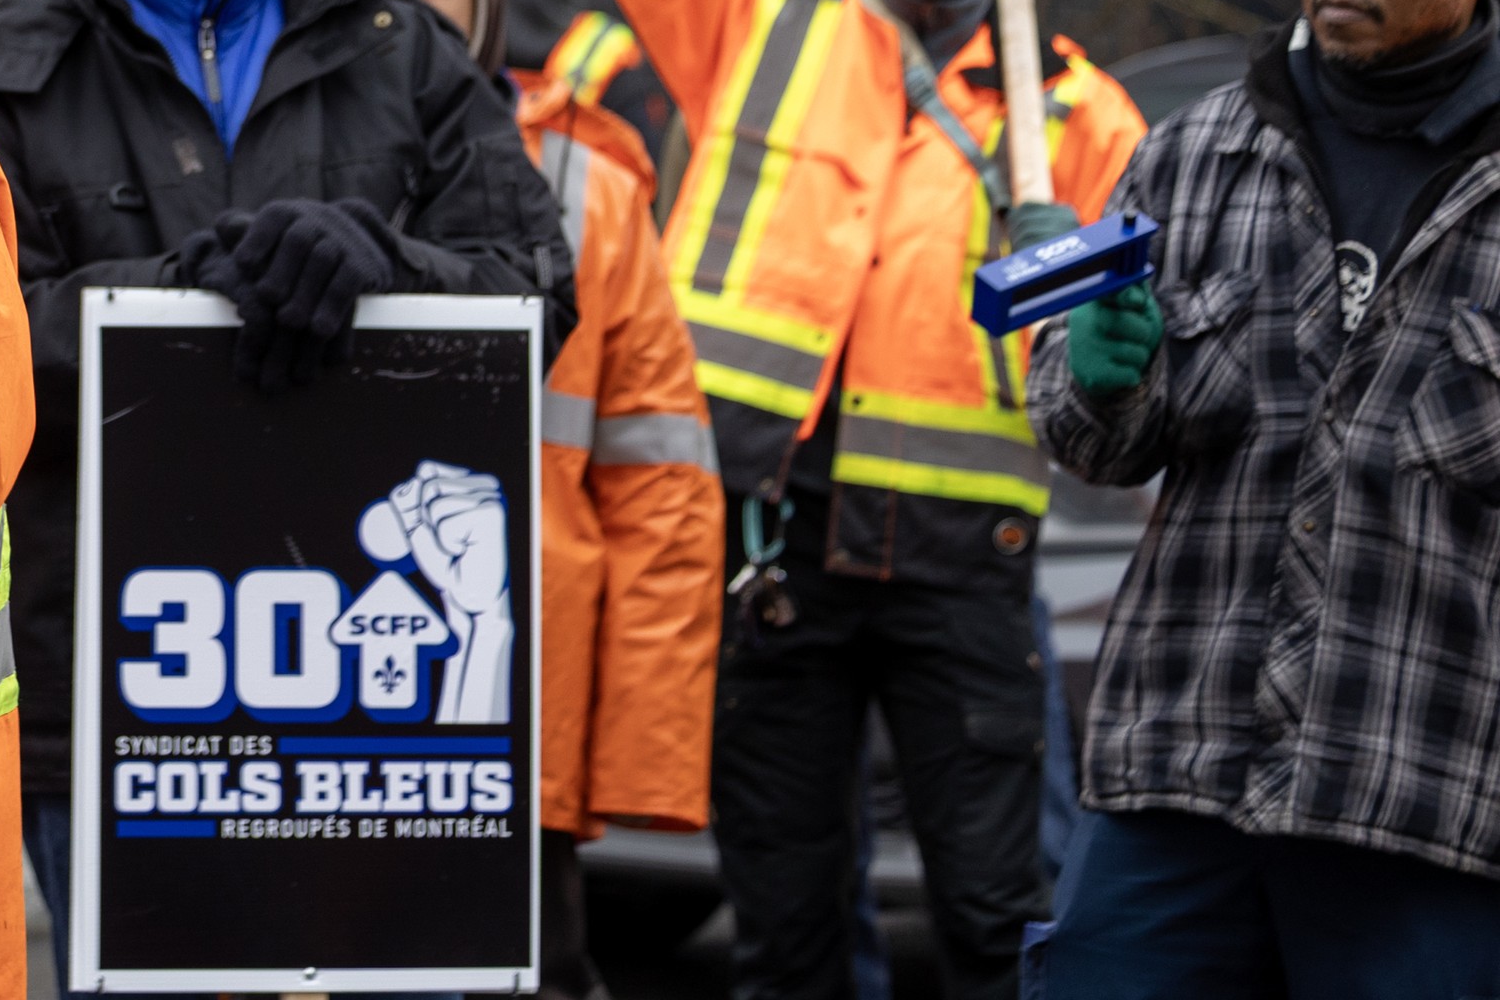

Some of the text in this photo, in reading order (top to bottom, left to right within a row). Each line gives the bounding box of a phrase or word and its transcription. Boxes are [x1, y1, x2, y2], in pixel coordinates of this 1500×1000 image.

[349, 614, 432, 637] SCFP
[115, 735, 273, 756] SYNDICAT DES
[114, 761, 513, 814] COLS BLEUS
[220, 814, 513, 839] REGROUPÉS DE MONTRÉAL
